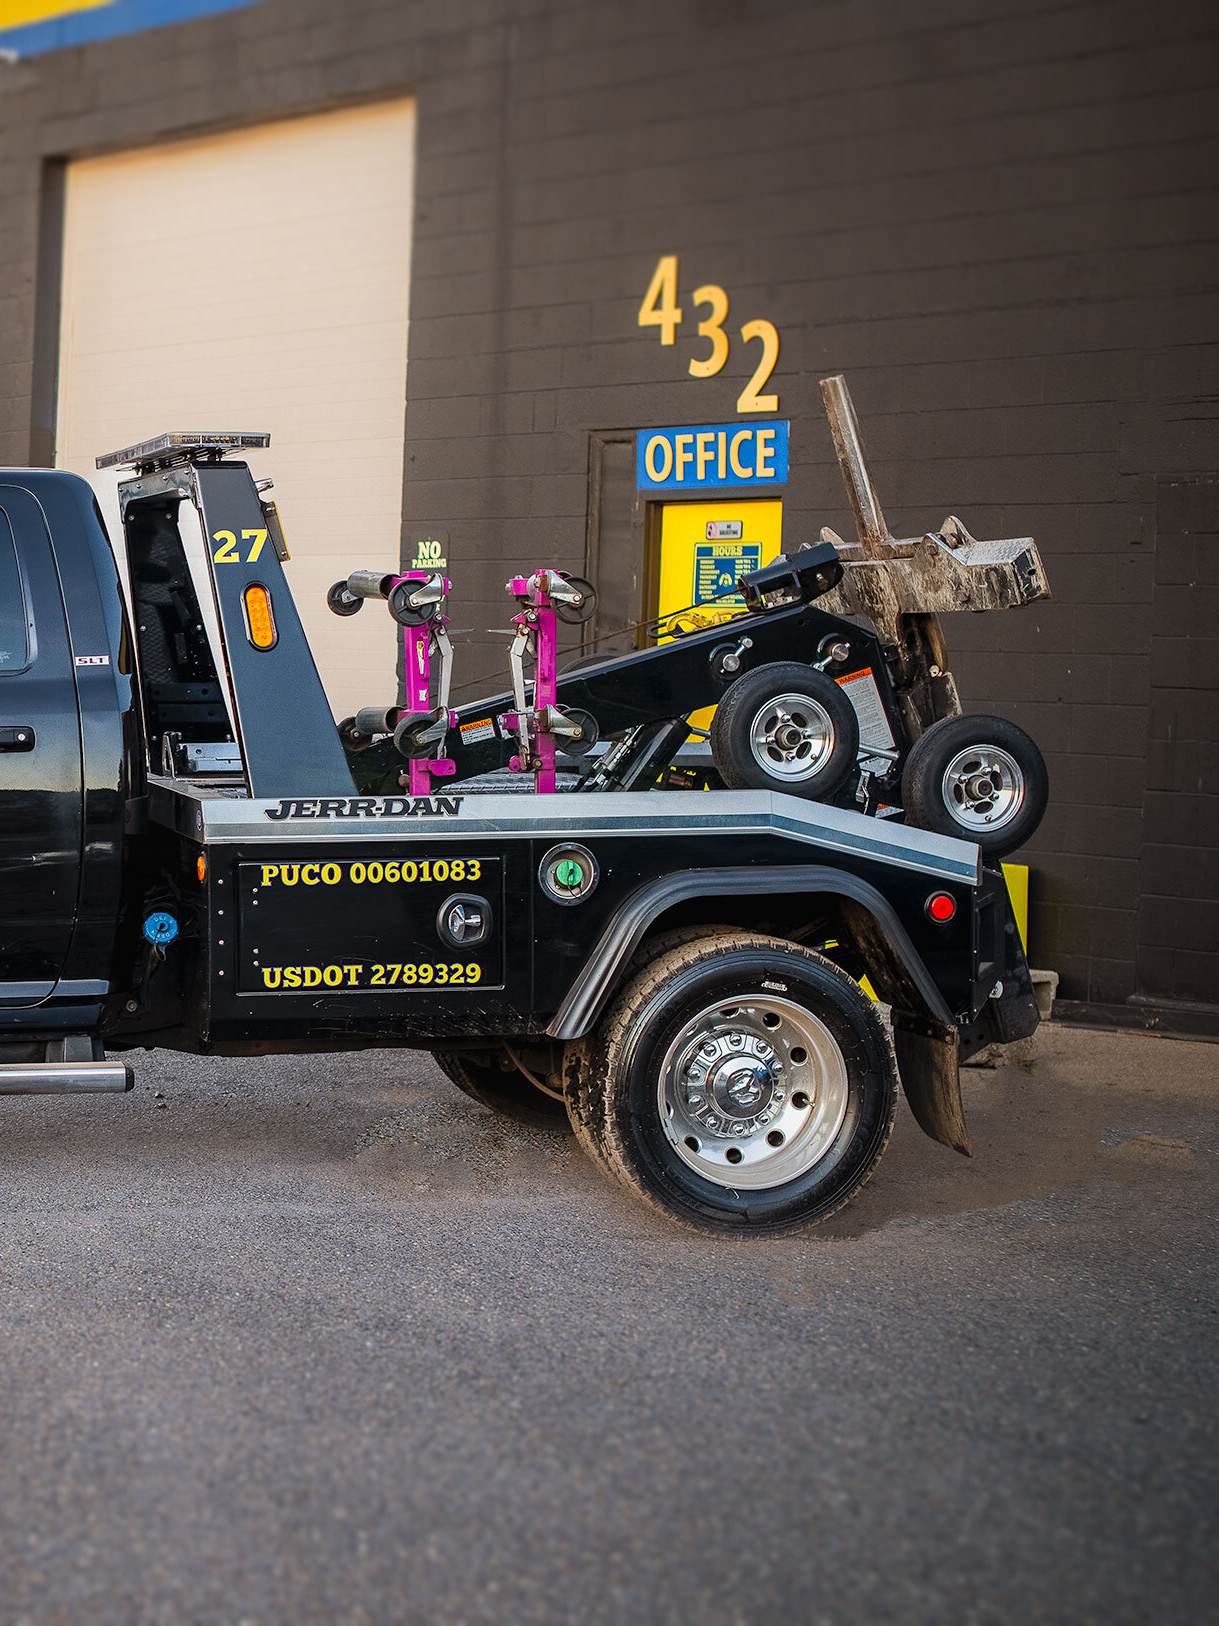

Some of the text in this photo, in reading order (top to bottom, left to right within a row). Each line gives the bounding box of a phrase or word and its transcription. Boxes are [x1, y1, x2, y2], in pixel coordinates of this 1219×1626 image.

[645, 429, 776, 482] OFFICE
[212, 528, 268, 564] 27
[417, 541, 442, 559] NO
[712, 545, 743, 556] HOURS
[411, 558, 447, 569] PARKING
[77, 656, 108, 665] SLT
[839, 670, 866, 684] WARNING
[264, 797, 464, 822] JERR-DAN
[261, 860, 482, 887] PUCO 00601083
[261, 963, 482, 988] USDOT 2789329
